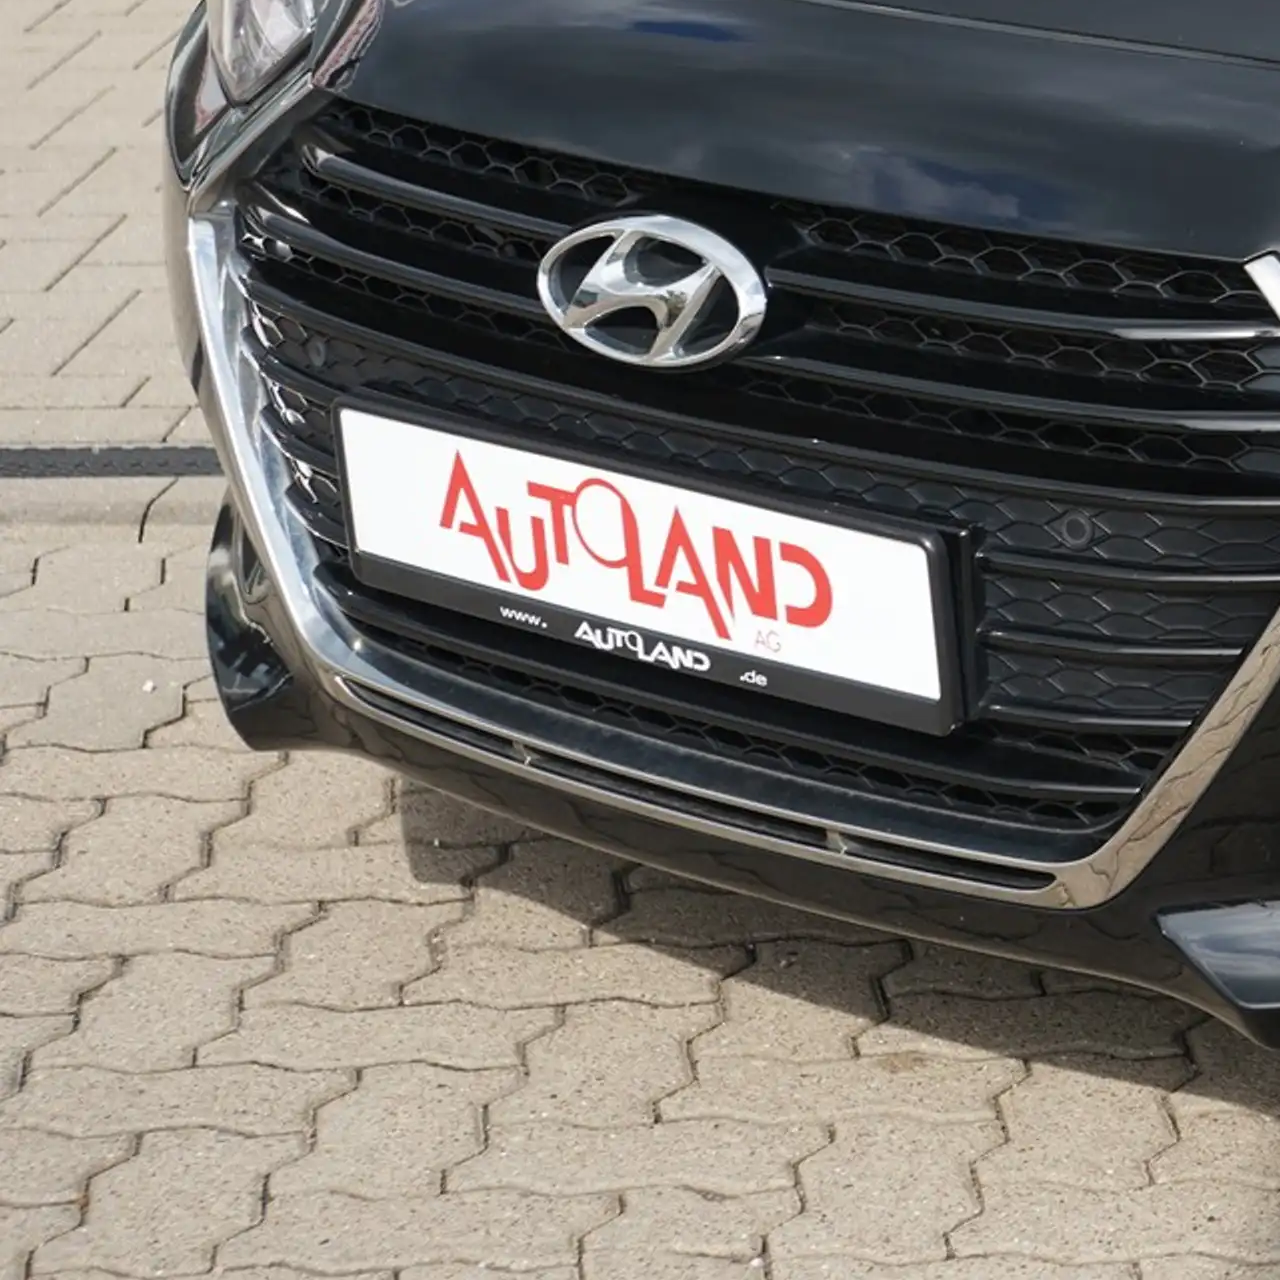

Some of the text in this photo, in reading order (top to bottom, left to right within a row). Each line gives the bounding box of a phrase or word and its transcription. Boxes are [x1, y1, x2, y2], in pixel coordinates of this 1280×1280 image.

[440, 449, 833, 641] AUTOLAND
[574, 621, 711, 671] AUTOLAND
[754, 629, 783, 654] AG
